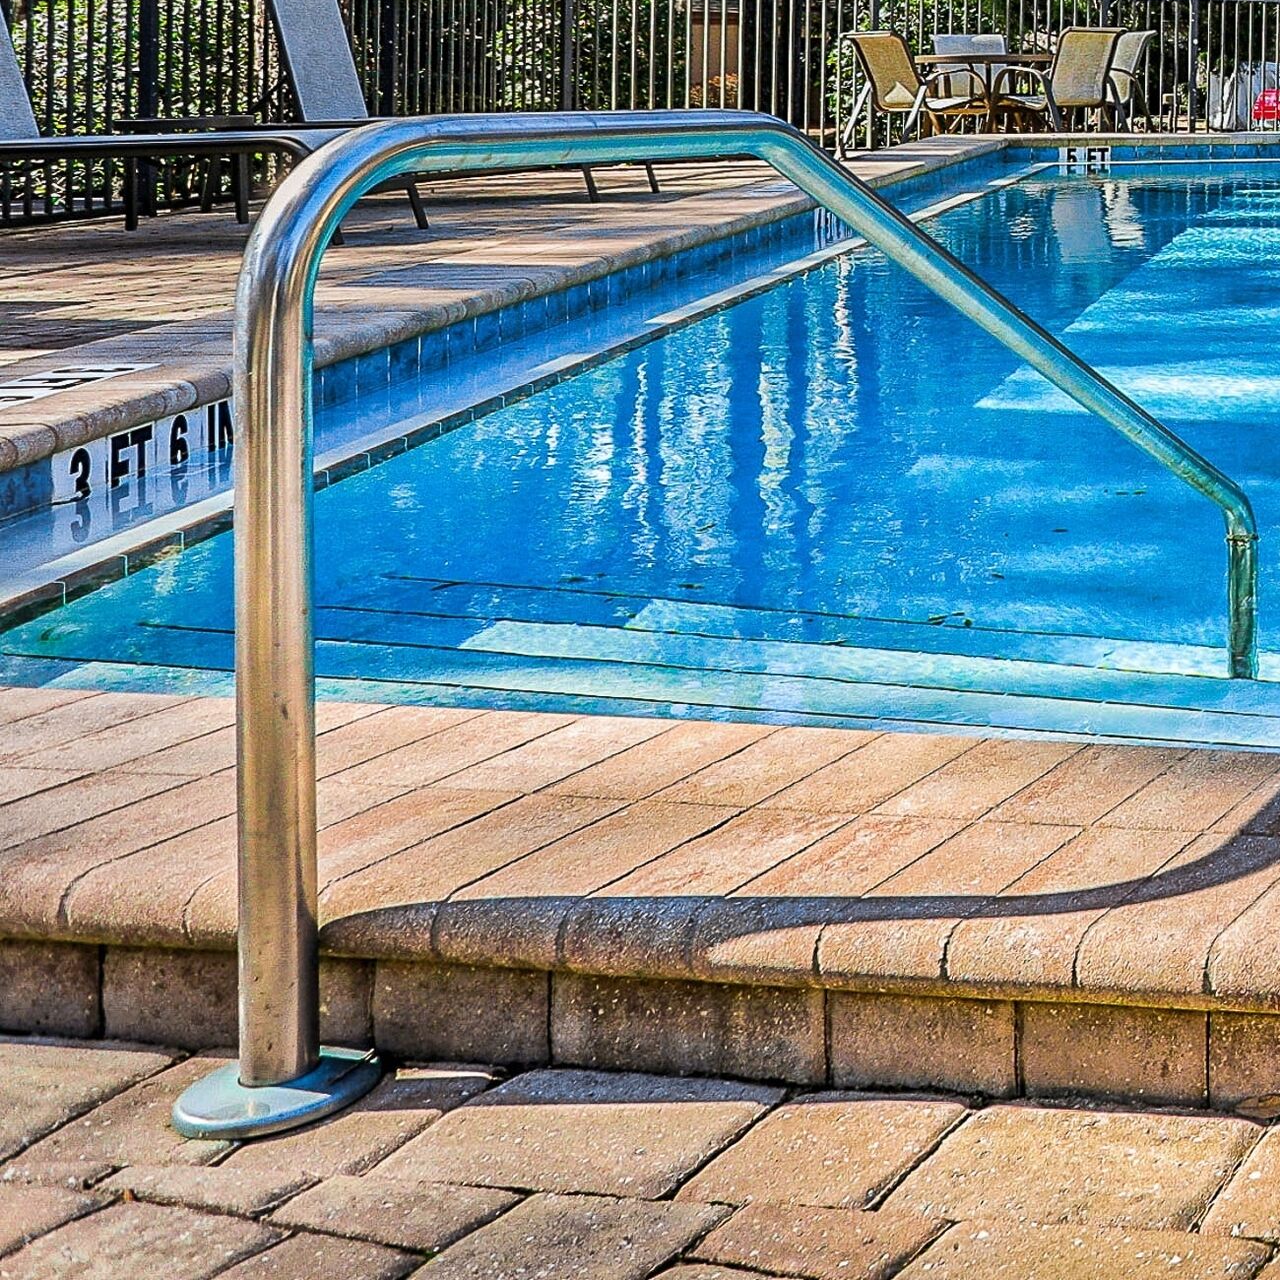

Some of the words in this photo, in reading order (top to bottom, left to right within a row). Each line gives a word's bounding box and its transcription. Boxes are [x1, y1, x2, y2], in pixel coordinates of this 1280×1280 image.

[1067, 148, 1077, 162] 5
[1087, 148, 1109, 162] FT
[69, 447, 92, 501] 3
[110, 423, 153, 489] FT
[170, 414, 189, 467] 6
